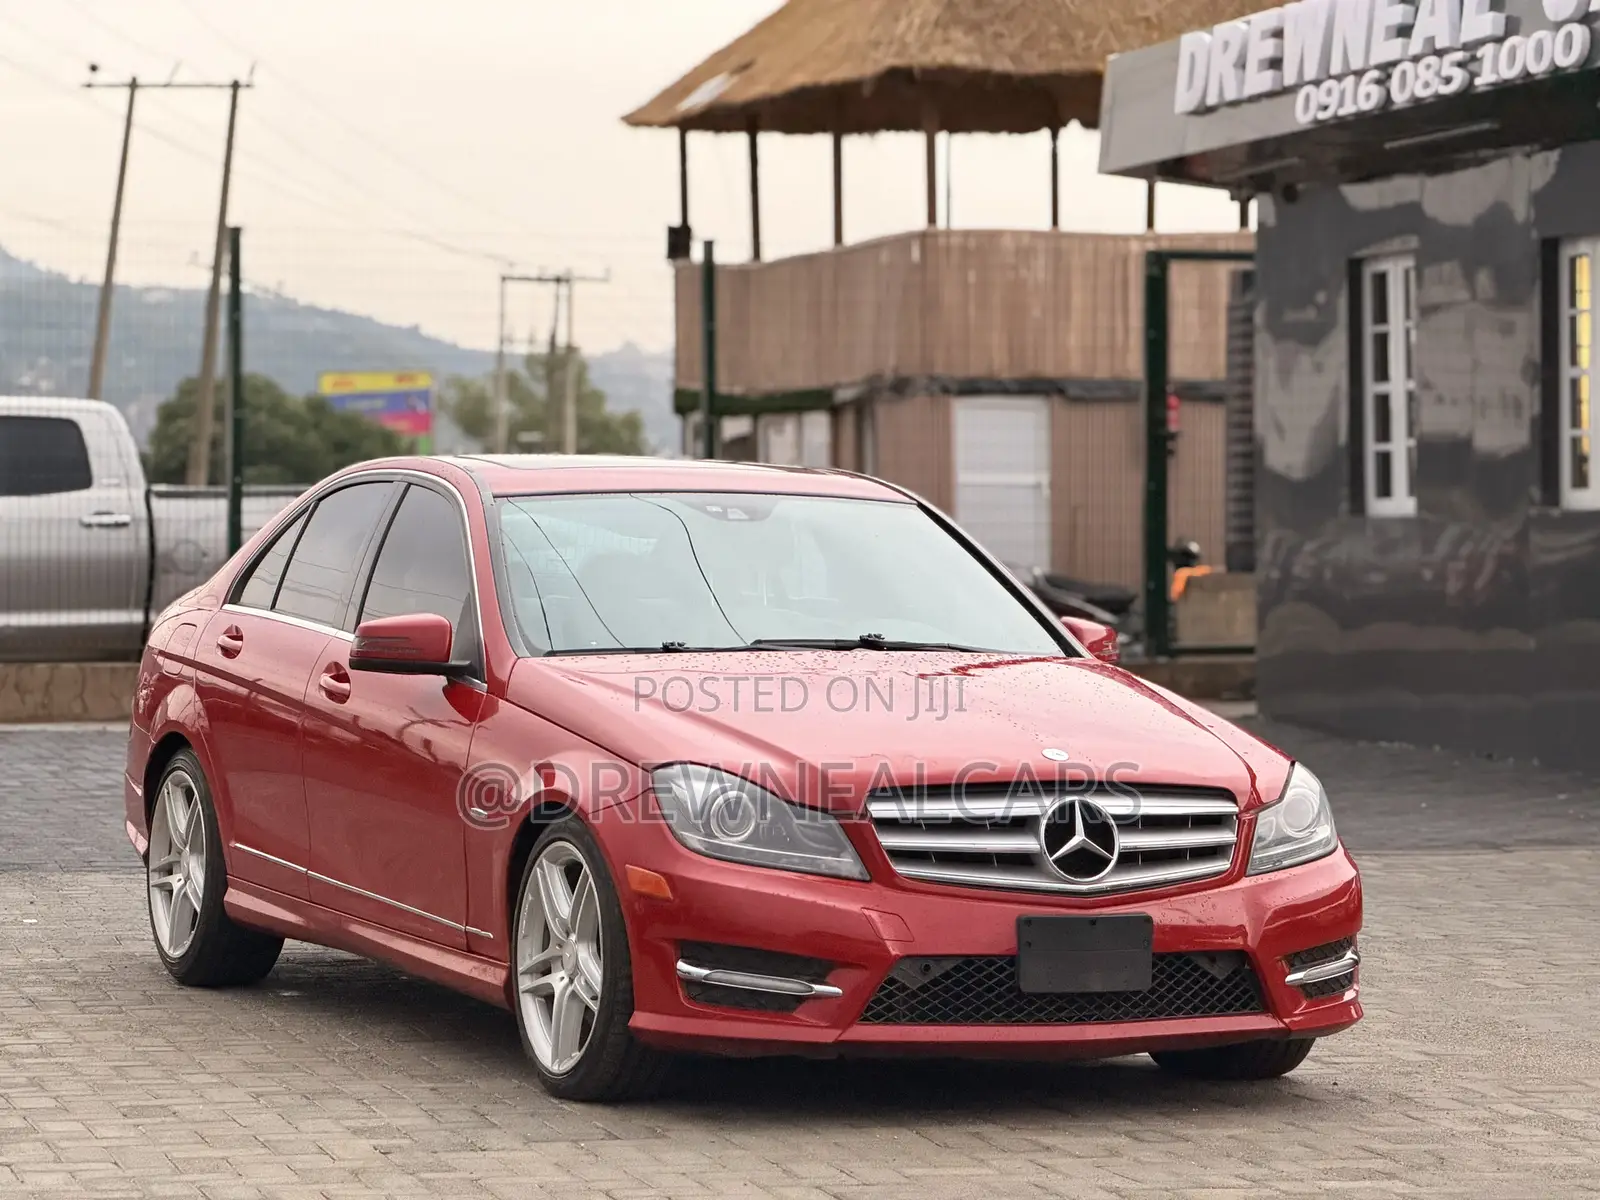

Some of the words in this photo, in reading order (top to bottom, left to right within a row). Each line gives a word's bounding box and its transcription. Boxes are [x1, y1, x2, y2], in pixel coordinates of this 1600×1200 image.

[1174, 0, 1506, 114] DREWNEAL
[1295, 69, 1386, 125] 0916
[1390, 51, 1470, 104] 085
[1474, 22, 1591, 86] 1000
